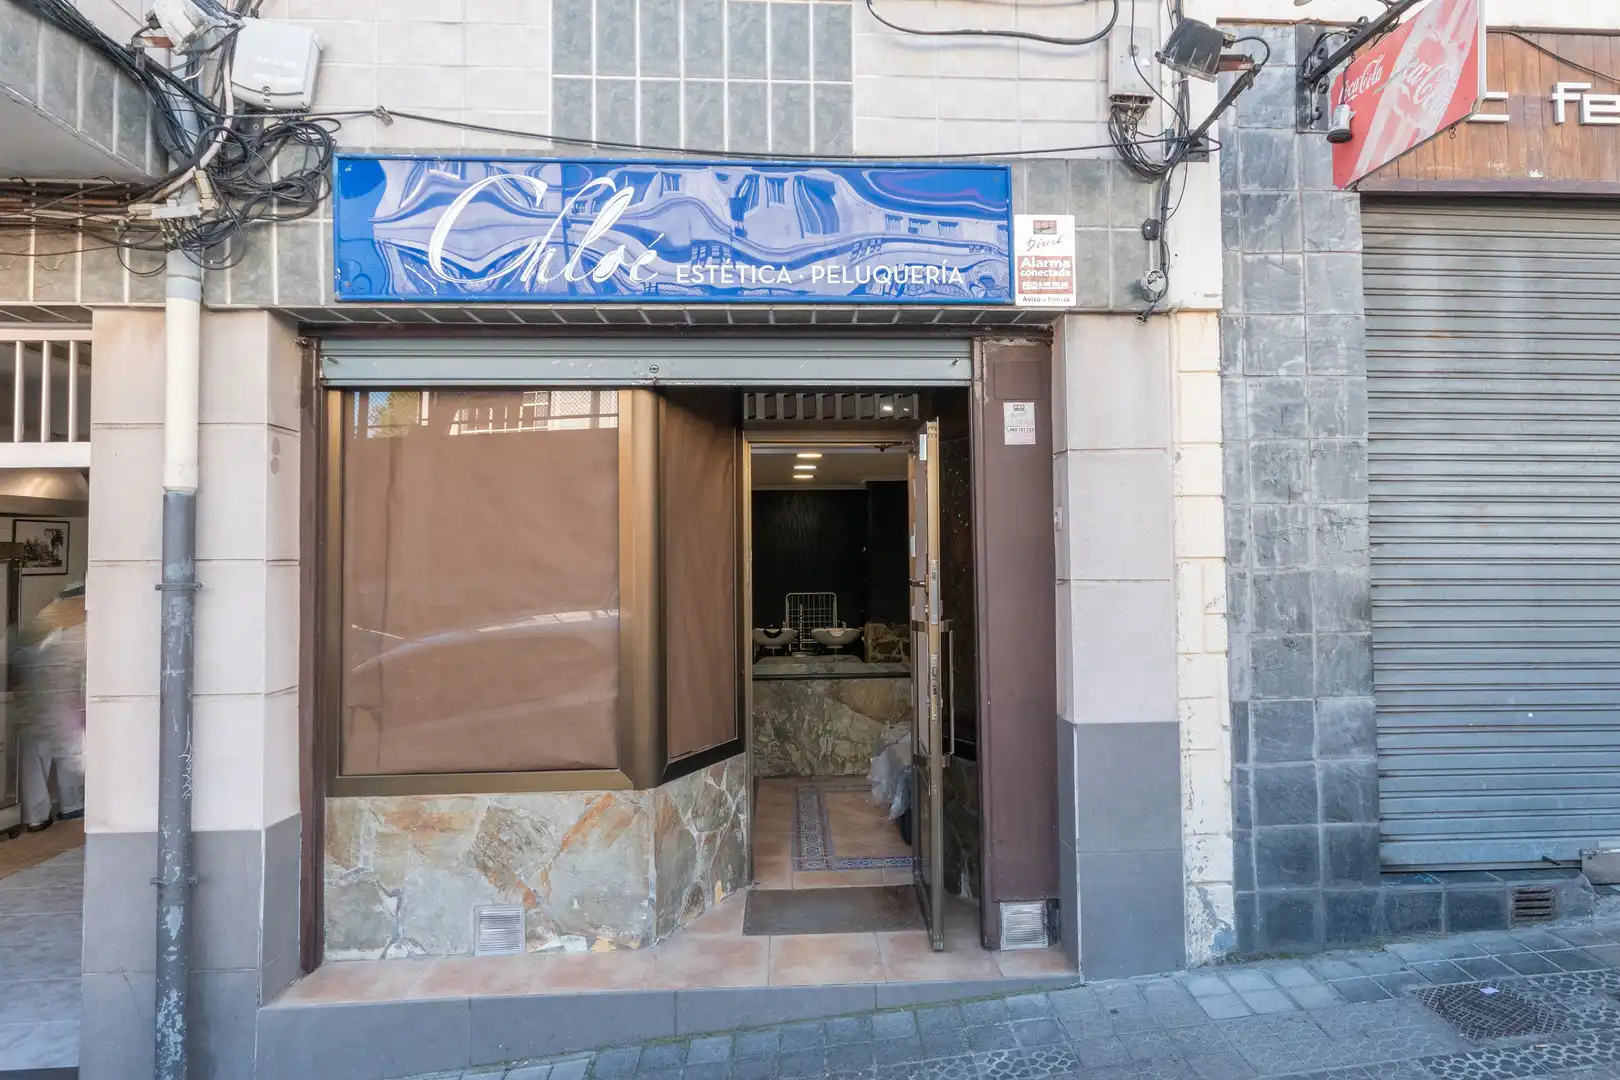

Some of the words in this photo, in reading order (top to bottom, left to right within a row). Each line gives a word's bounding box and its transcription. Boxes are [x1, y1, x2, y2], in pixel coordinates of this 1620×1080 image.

[428, 173, 666, 285] Chloé
[1020, 256, 1071, 268] Alarma
[676, 260, 793, 285] ESTÉTICA
[811, 259, 964, 286] PELUQUERÍA
[1020, 267, 1071, 277] conectada
